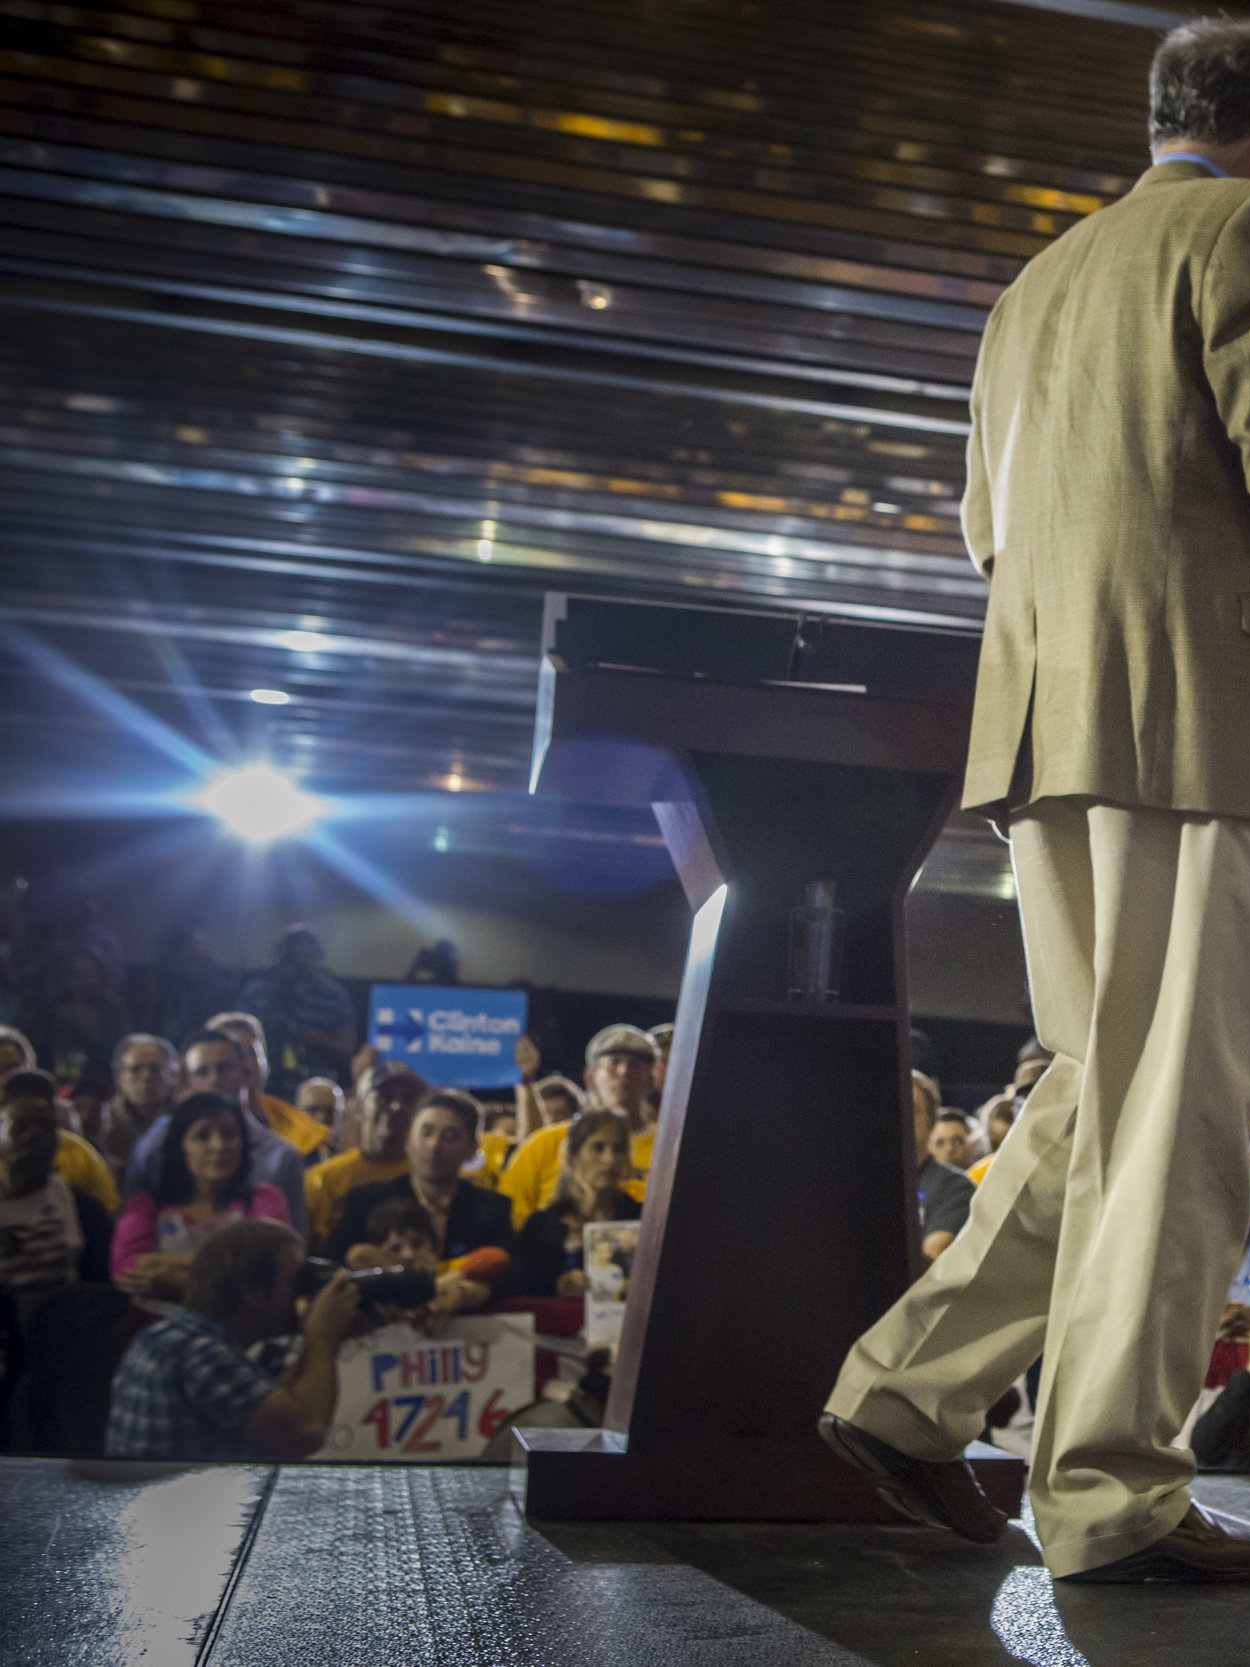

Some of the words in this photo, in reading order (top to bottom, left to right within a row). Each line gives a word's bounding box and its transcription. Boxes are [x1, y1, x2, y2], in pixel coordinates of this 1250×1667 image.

[428, 1009, 521, 1035] Clinton
[428, 1032, 502, 1055] Kaine
[362, 1388, 511, 1454] 47246
